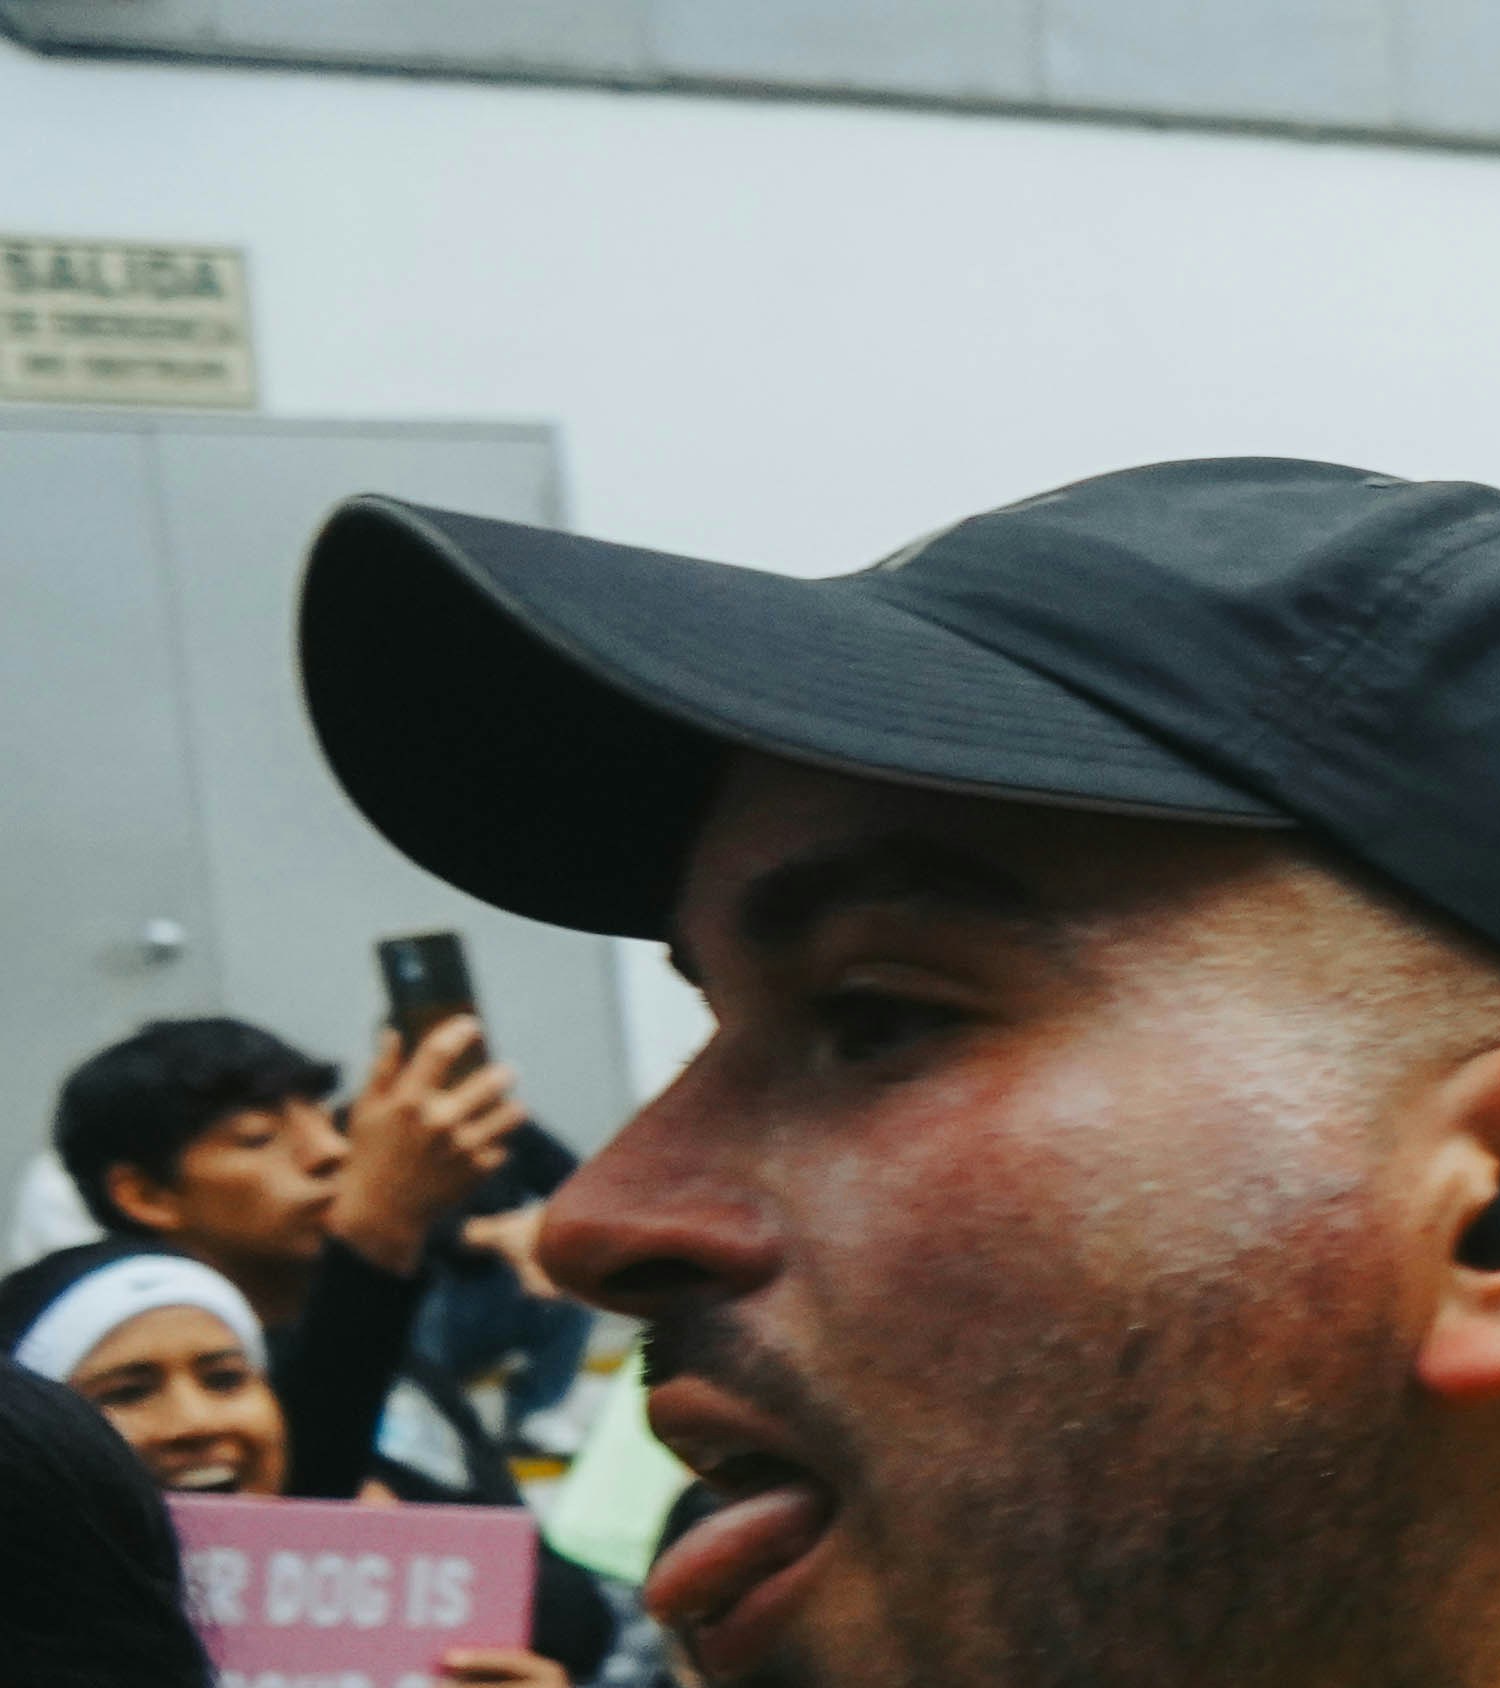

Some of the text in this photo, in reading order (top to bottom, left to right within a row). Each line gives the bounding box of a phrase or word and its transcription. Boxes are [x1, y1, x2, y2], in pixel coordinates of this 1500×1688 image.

[4, 251, 223, 299] SALIDA
[265, 1549, 391, 1628] DOG
[405, 1553, 474, 1628] IS
